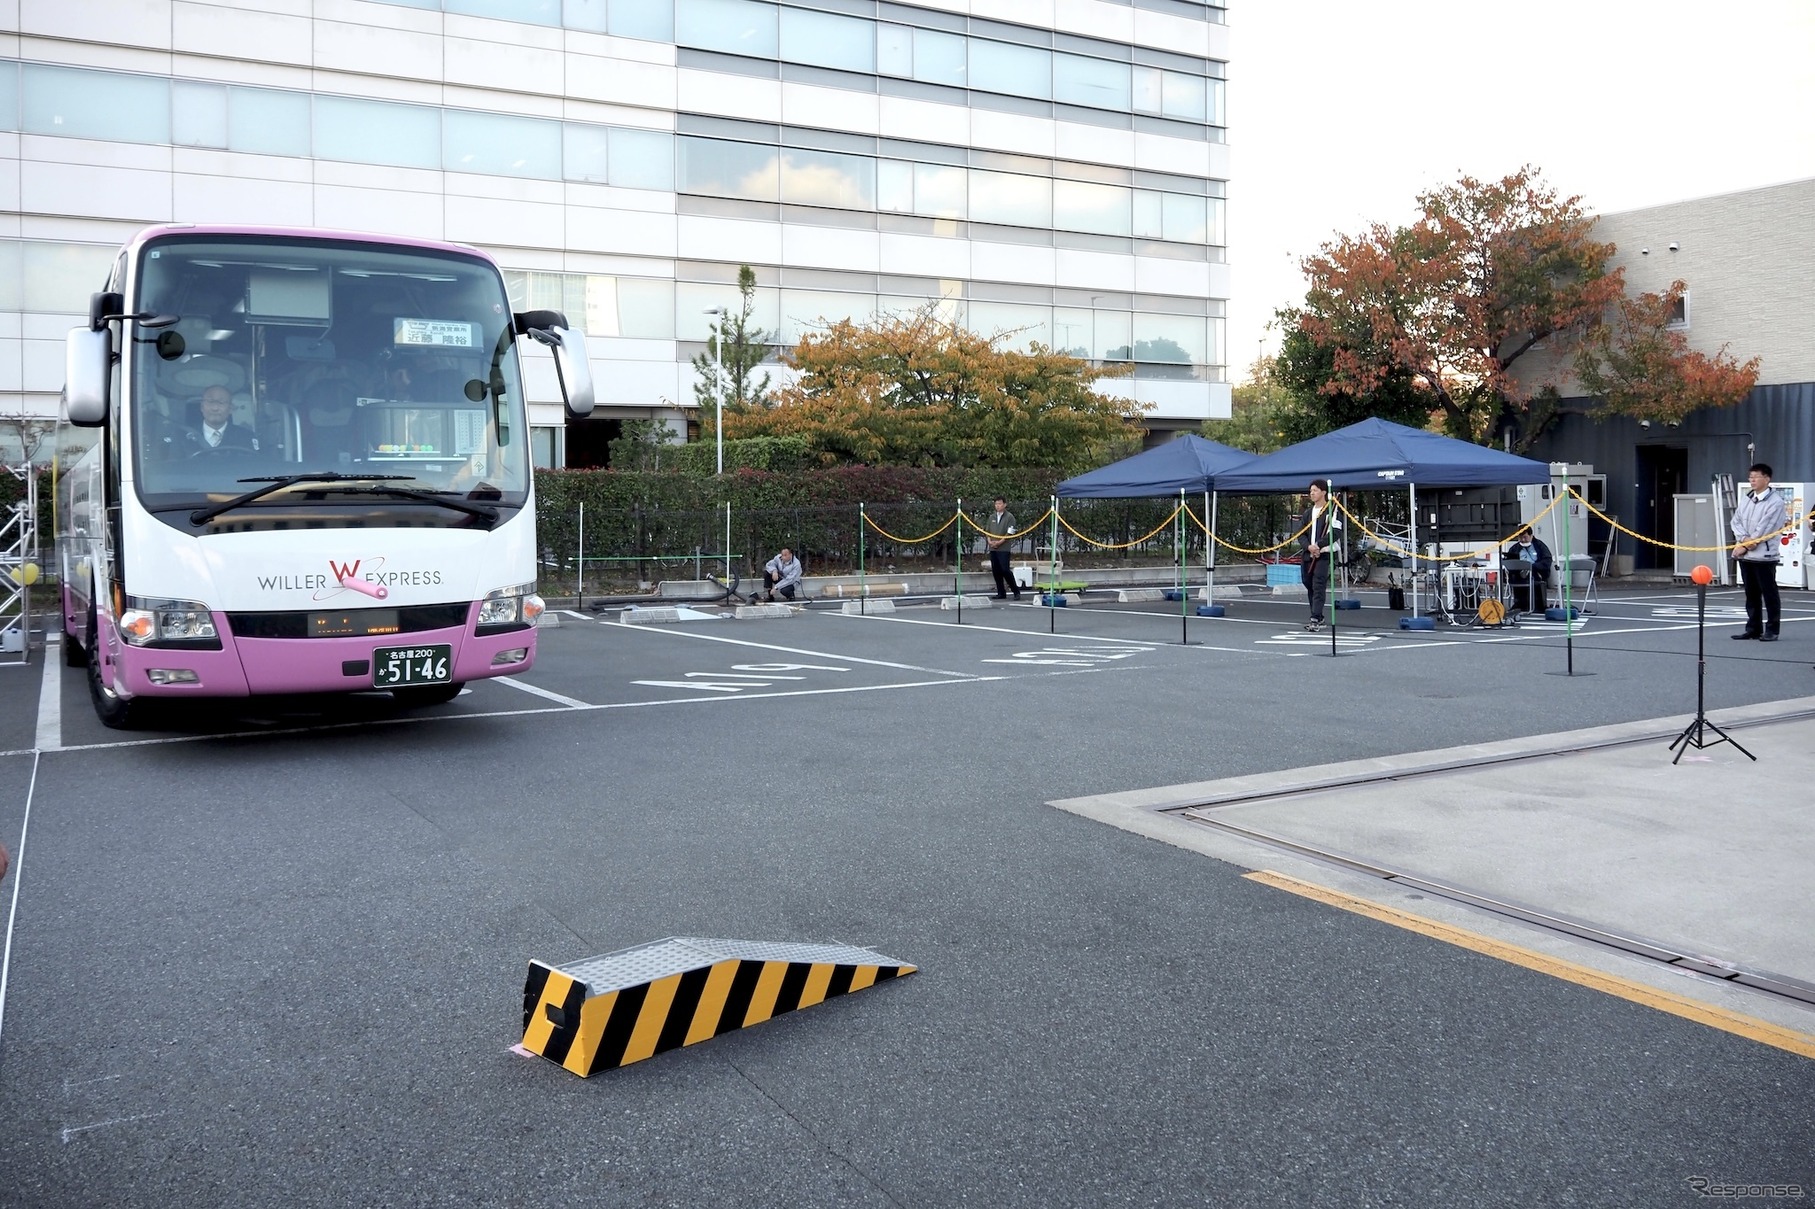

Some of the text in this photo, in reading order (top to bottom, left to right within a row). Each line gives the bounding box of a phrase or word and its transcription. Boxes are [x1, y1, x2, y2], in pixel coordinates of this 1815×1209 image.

[257, 574, 326, 590] WILLER
[365, 570, 442, 587] EXPRESS
[390, 649, 433, 660] 名古屋200
[378, 657, 447, 682] か 51-46
[629, 662, 852, 692] A19
